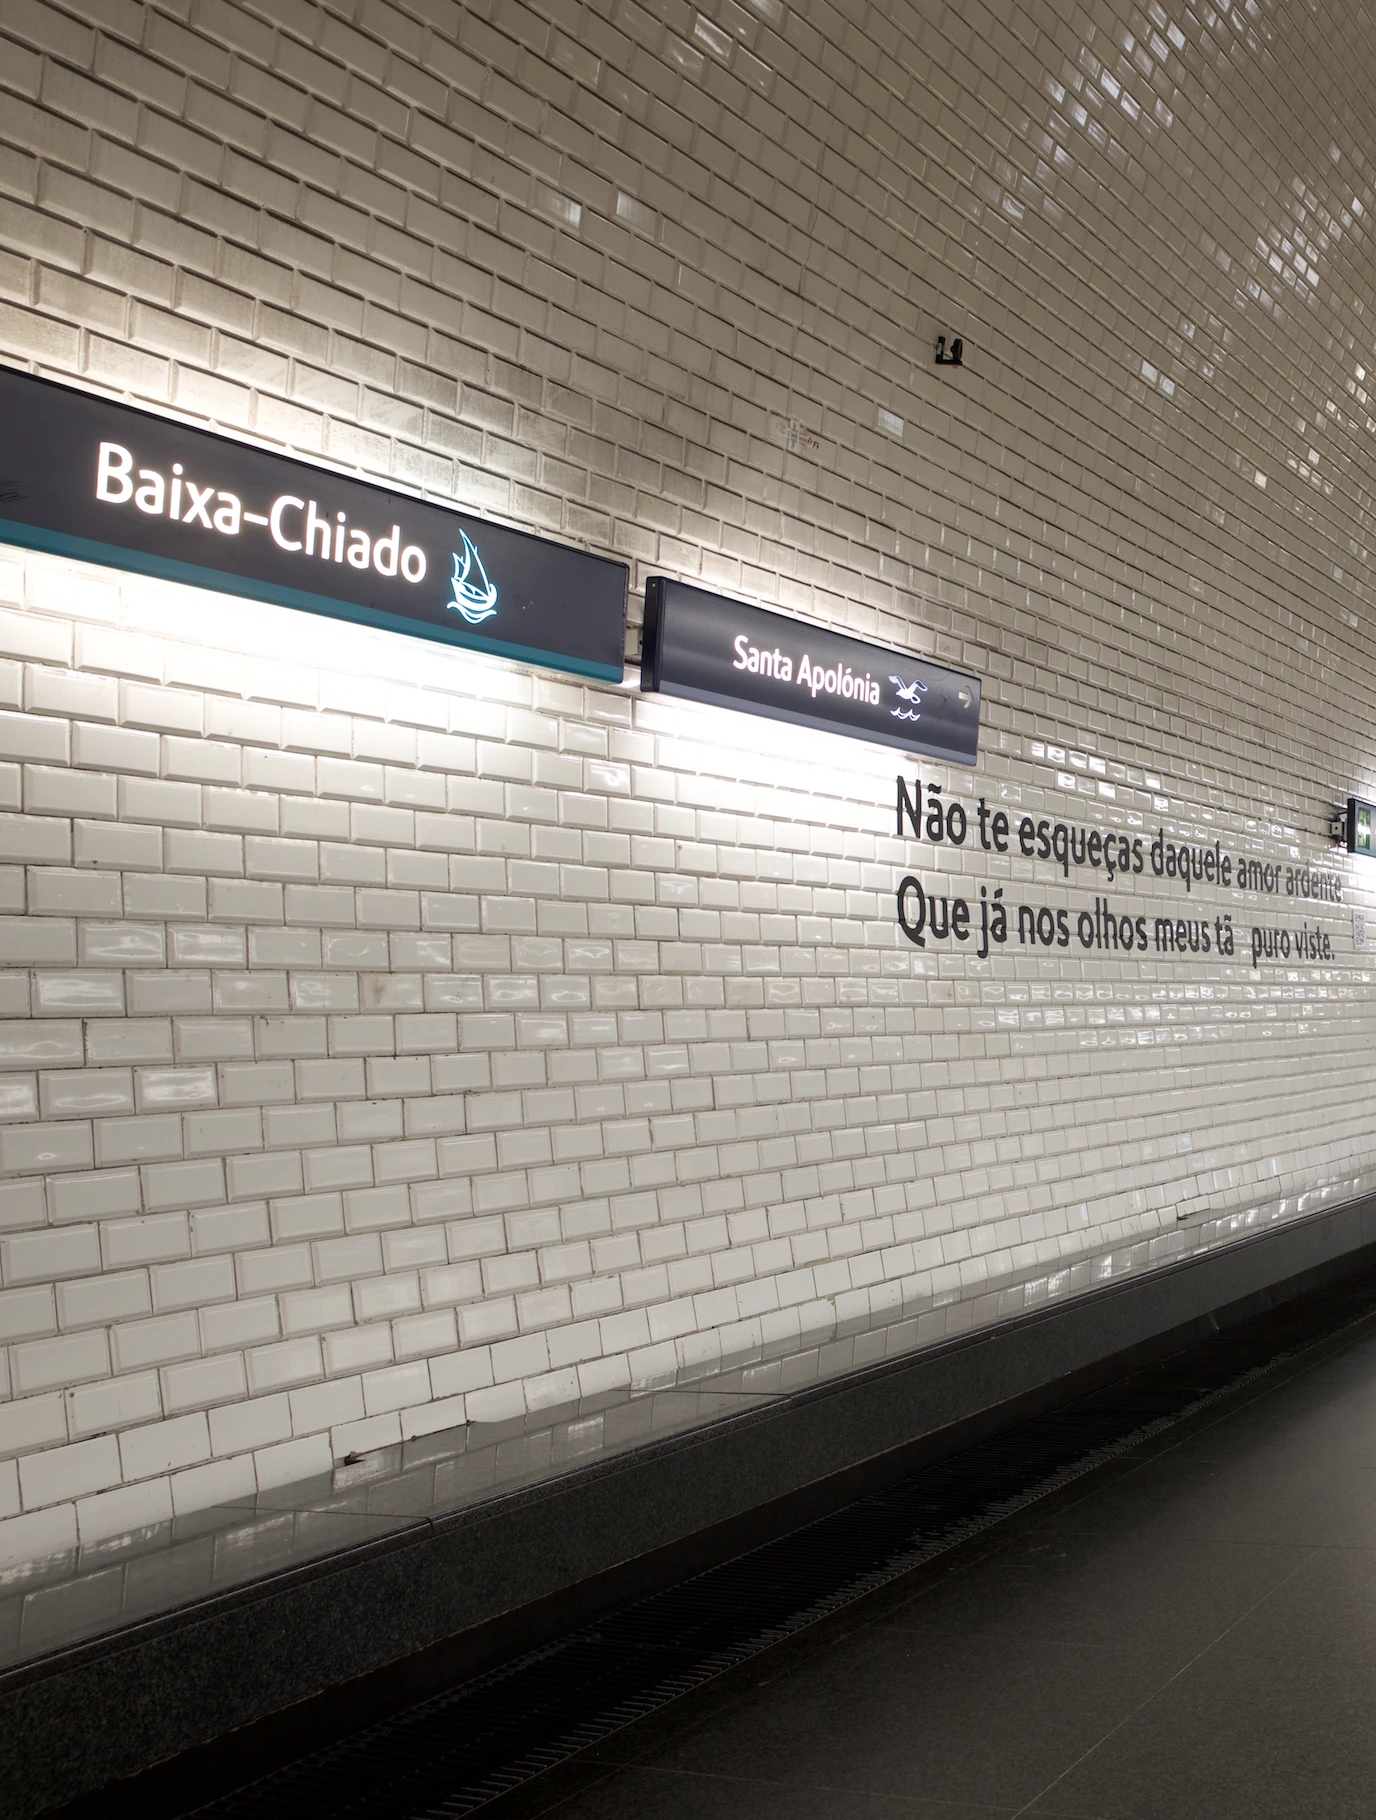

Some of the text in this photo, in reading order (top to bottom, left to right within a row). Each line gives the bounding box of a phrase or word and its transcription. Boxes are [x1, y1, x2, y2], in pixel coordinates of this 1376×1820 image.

[95, 441, 428, 584] Baixa-Chiado
[733, 634, 881, 706] Santa Apolónia
[896, 775, 967, 846] Não
[977, 797, 1010, 852] te
[1018, 816, 1144, 882] esqueças
[1150, 827, 1232, 893] daquele
[1237, 857, 1282, 894] amor
[897, 875, 970, 948] Que
[977, 885, 1008, 959] já
[1018, 905, 1070, 947] nos
[1077, 896, 1148, 952] olhos
[1155, 917, 1212, 952] meus
[1251, 926, 1291, 969] puro
[1295, 921, 1335, 961] viste.
